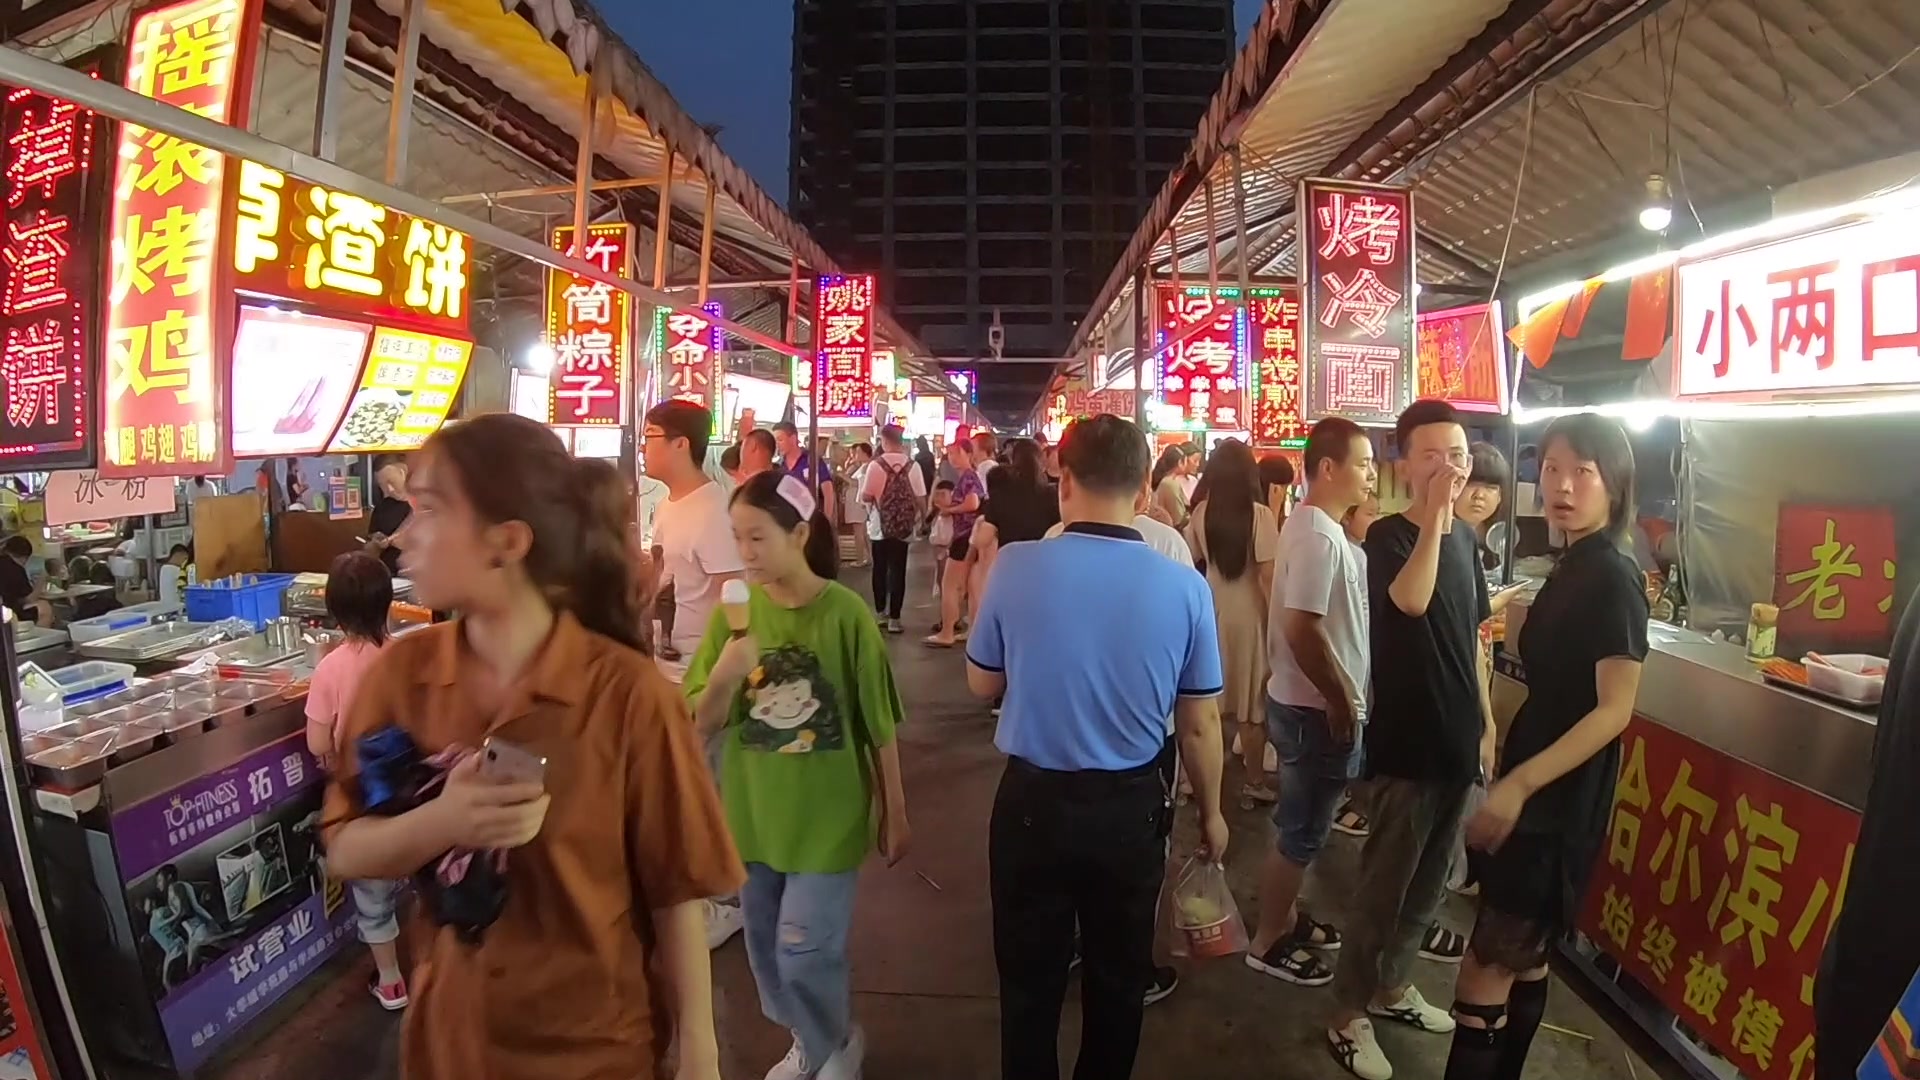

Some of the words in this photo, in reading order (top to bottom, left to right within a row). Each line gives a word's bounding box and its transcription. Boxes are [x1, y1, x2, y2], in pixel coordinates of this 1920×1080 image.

[1, 98, 75, 428] 掉渣饼
[108, 8, 236, 405] 摇滚烤鸡
[556, 236, 620, 417] 竹筒粽子
[1318, 192, 1402, 412] 烤冷面
[1695, 254, 1920, 379] 小两口
[140, 423, 175, 465] 鸡翅
[180, 420, 216, 464] 鸡
[1781, 518, 1897, 620] 老
[247, 751, 331, 806] 拓普
[229, 909, 315, 985] 试营业
